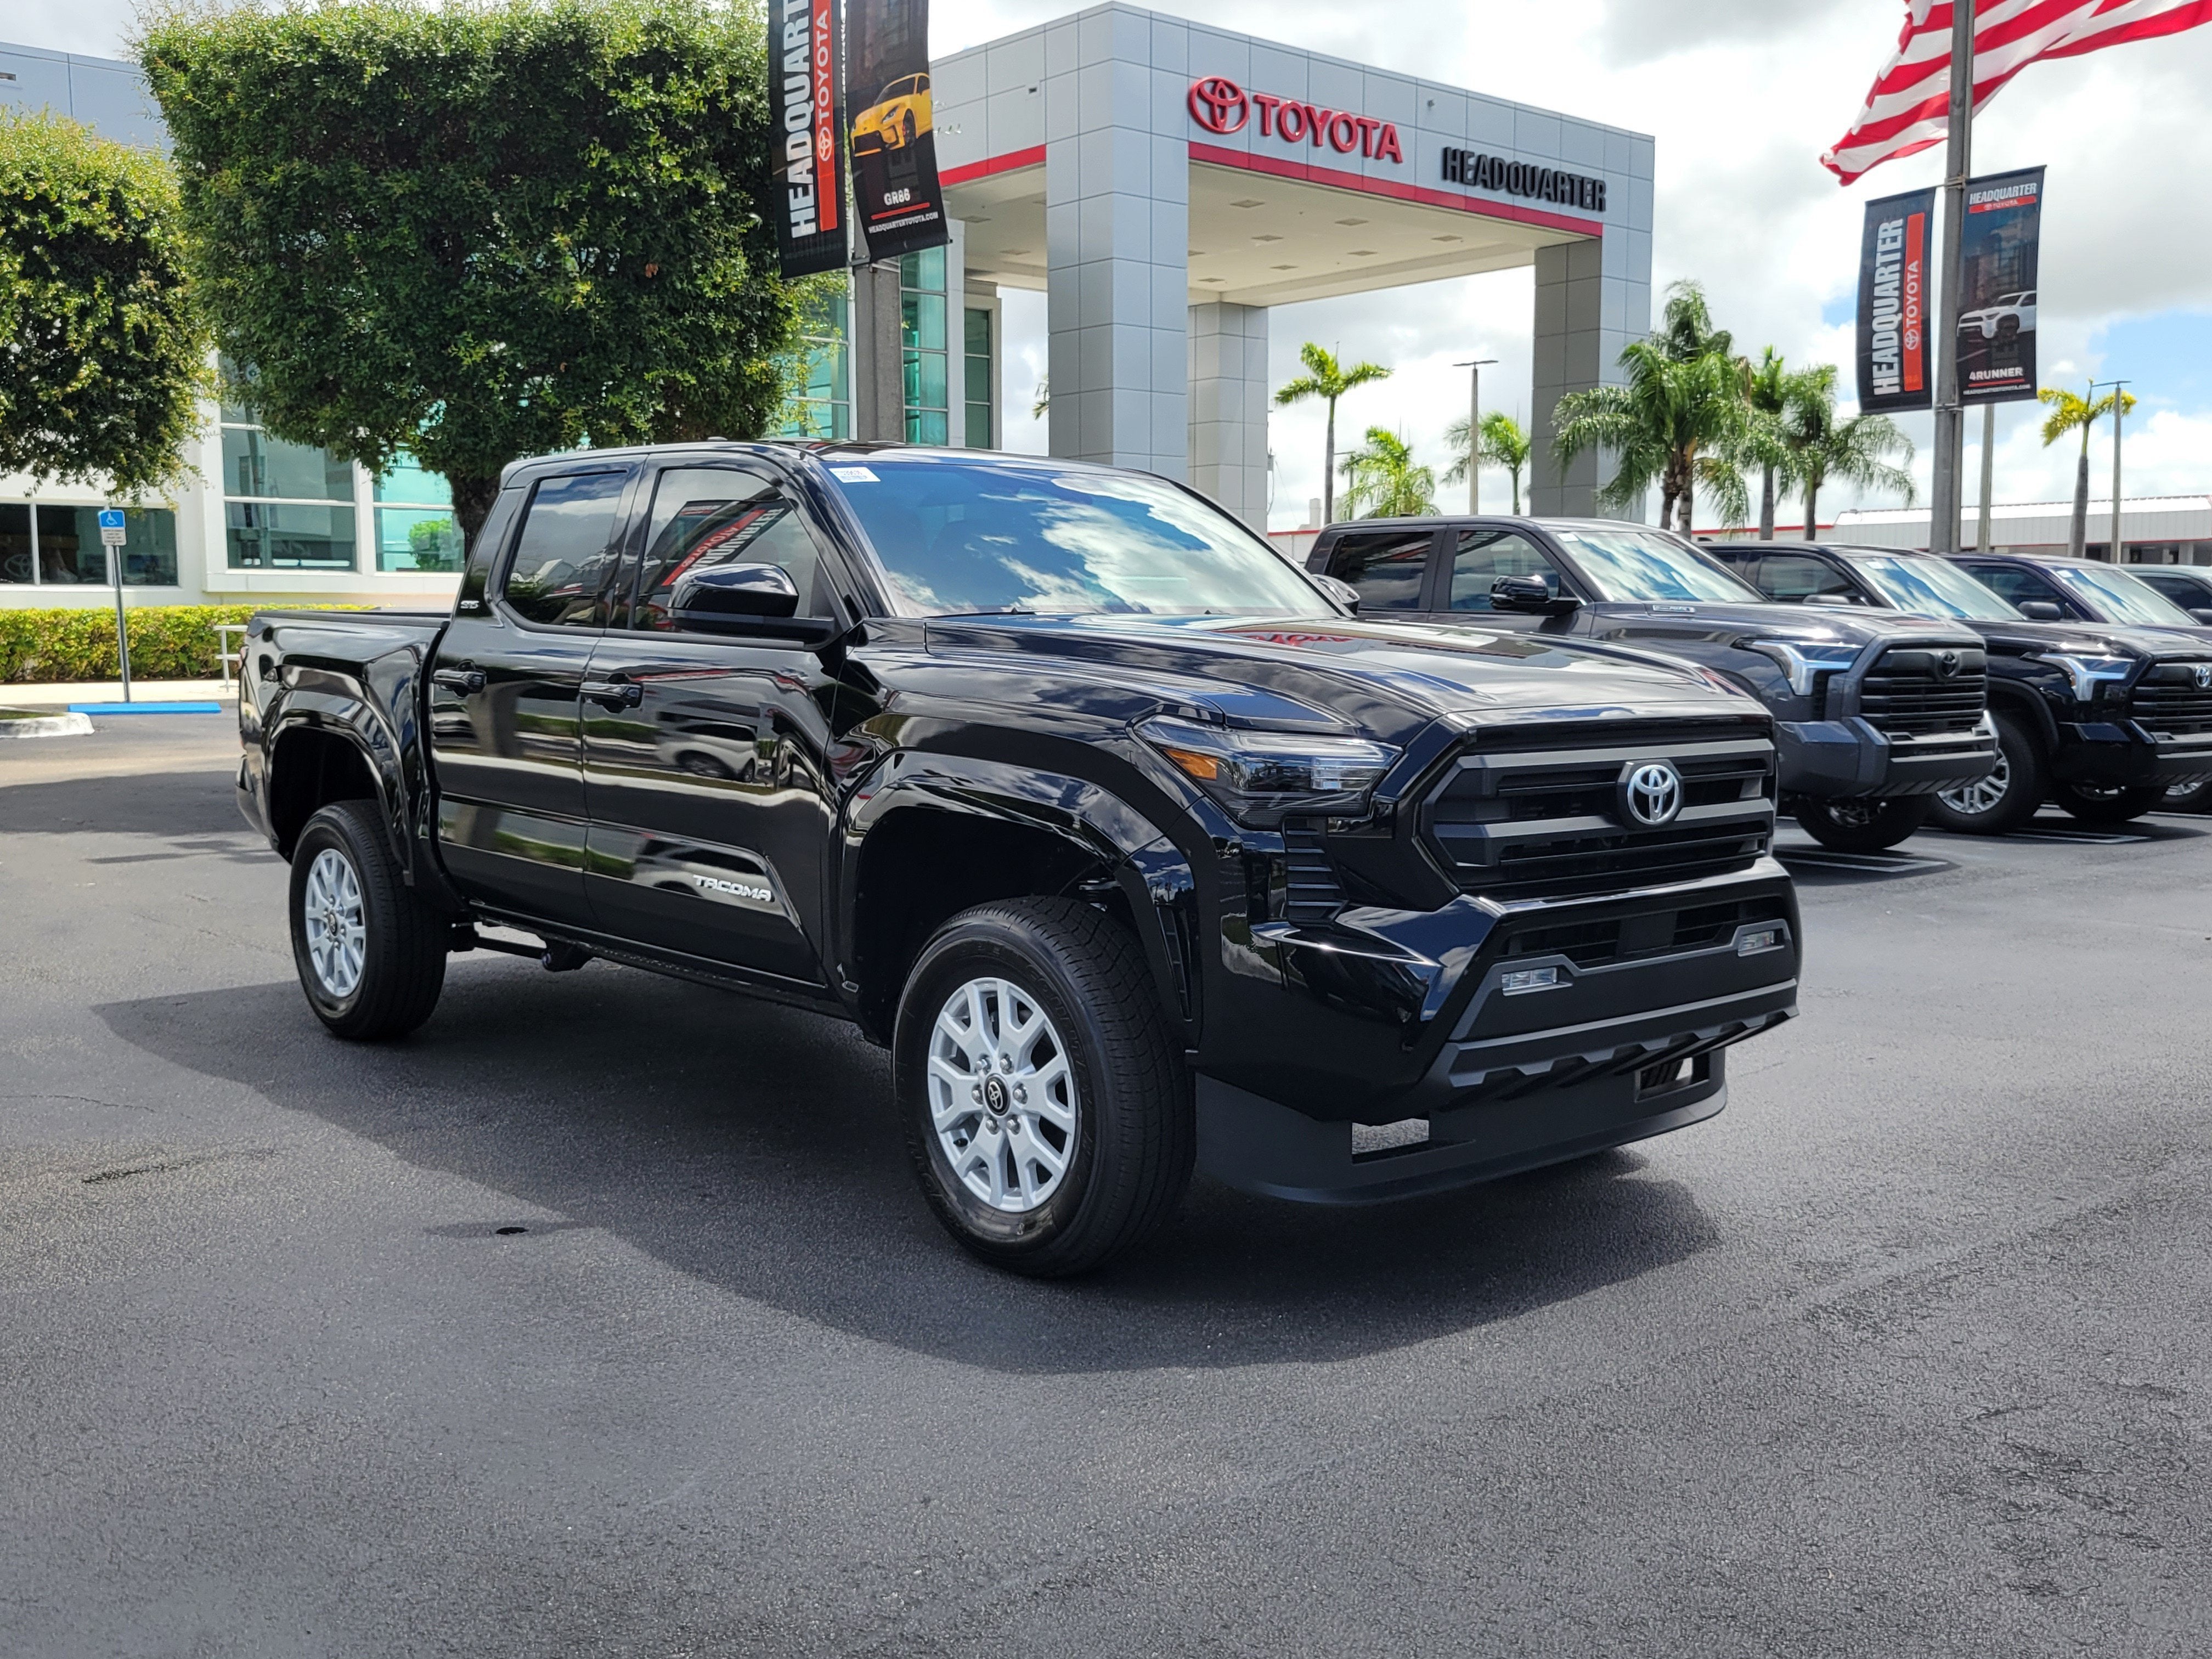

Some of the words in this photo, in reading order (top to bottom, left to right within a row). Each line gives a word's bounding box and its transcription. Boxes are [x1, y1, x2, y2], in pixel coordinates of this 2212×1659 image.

[816, 9, 830, 125] TOYOTA
[1253, 94, 1403, 164] TOYOTA
[884, 188, 911, 206] GR86
[1442, 146, 1606, 212] HEADQUARTER
[1969, 182, 2037, 205] HEADQUARTER
[1872, 218, 1903, 396] HEADQUARTER
[1906, 260, 1918, 329] TOYOTA
[1969, 366, 2023, 381] 4RUNNER
[693, 874, 772, 902] TACOMA
